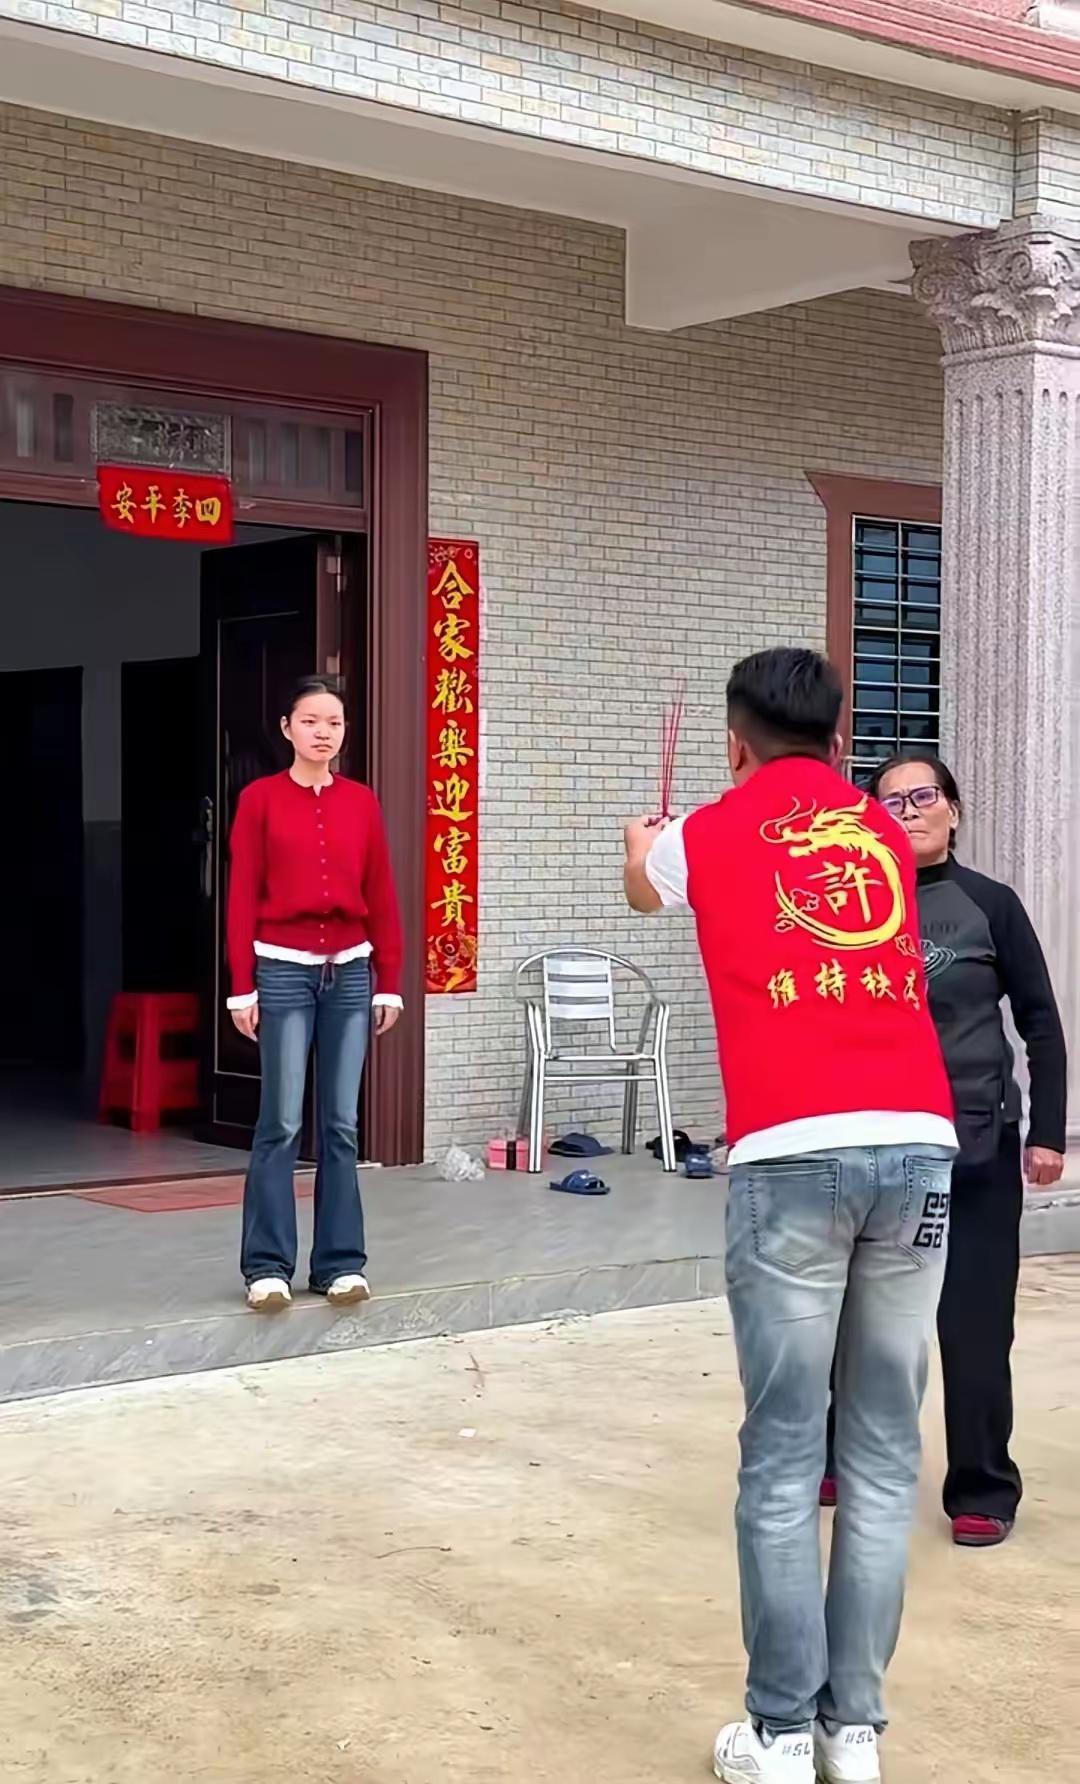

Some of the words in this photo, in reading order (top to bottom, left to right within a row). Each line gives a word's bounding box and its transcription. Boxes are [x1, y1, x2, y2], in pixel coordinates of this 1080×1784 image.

[430, 560, 475, 927] 合家歡樂迎富貴
[806, 861, 883, 923] 許
